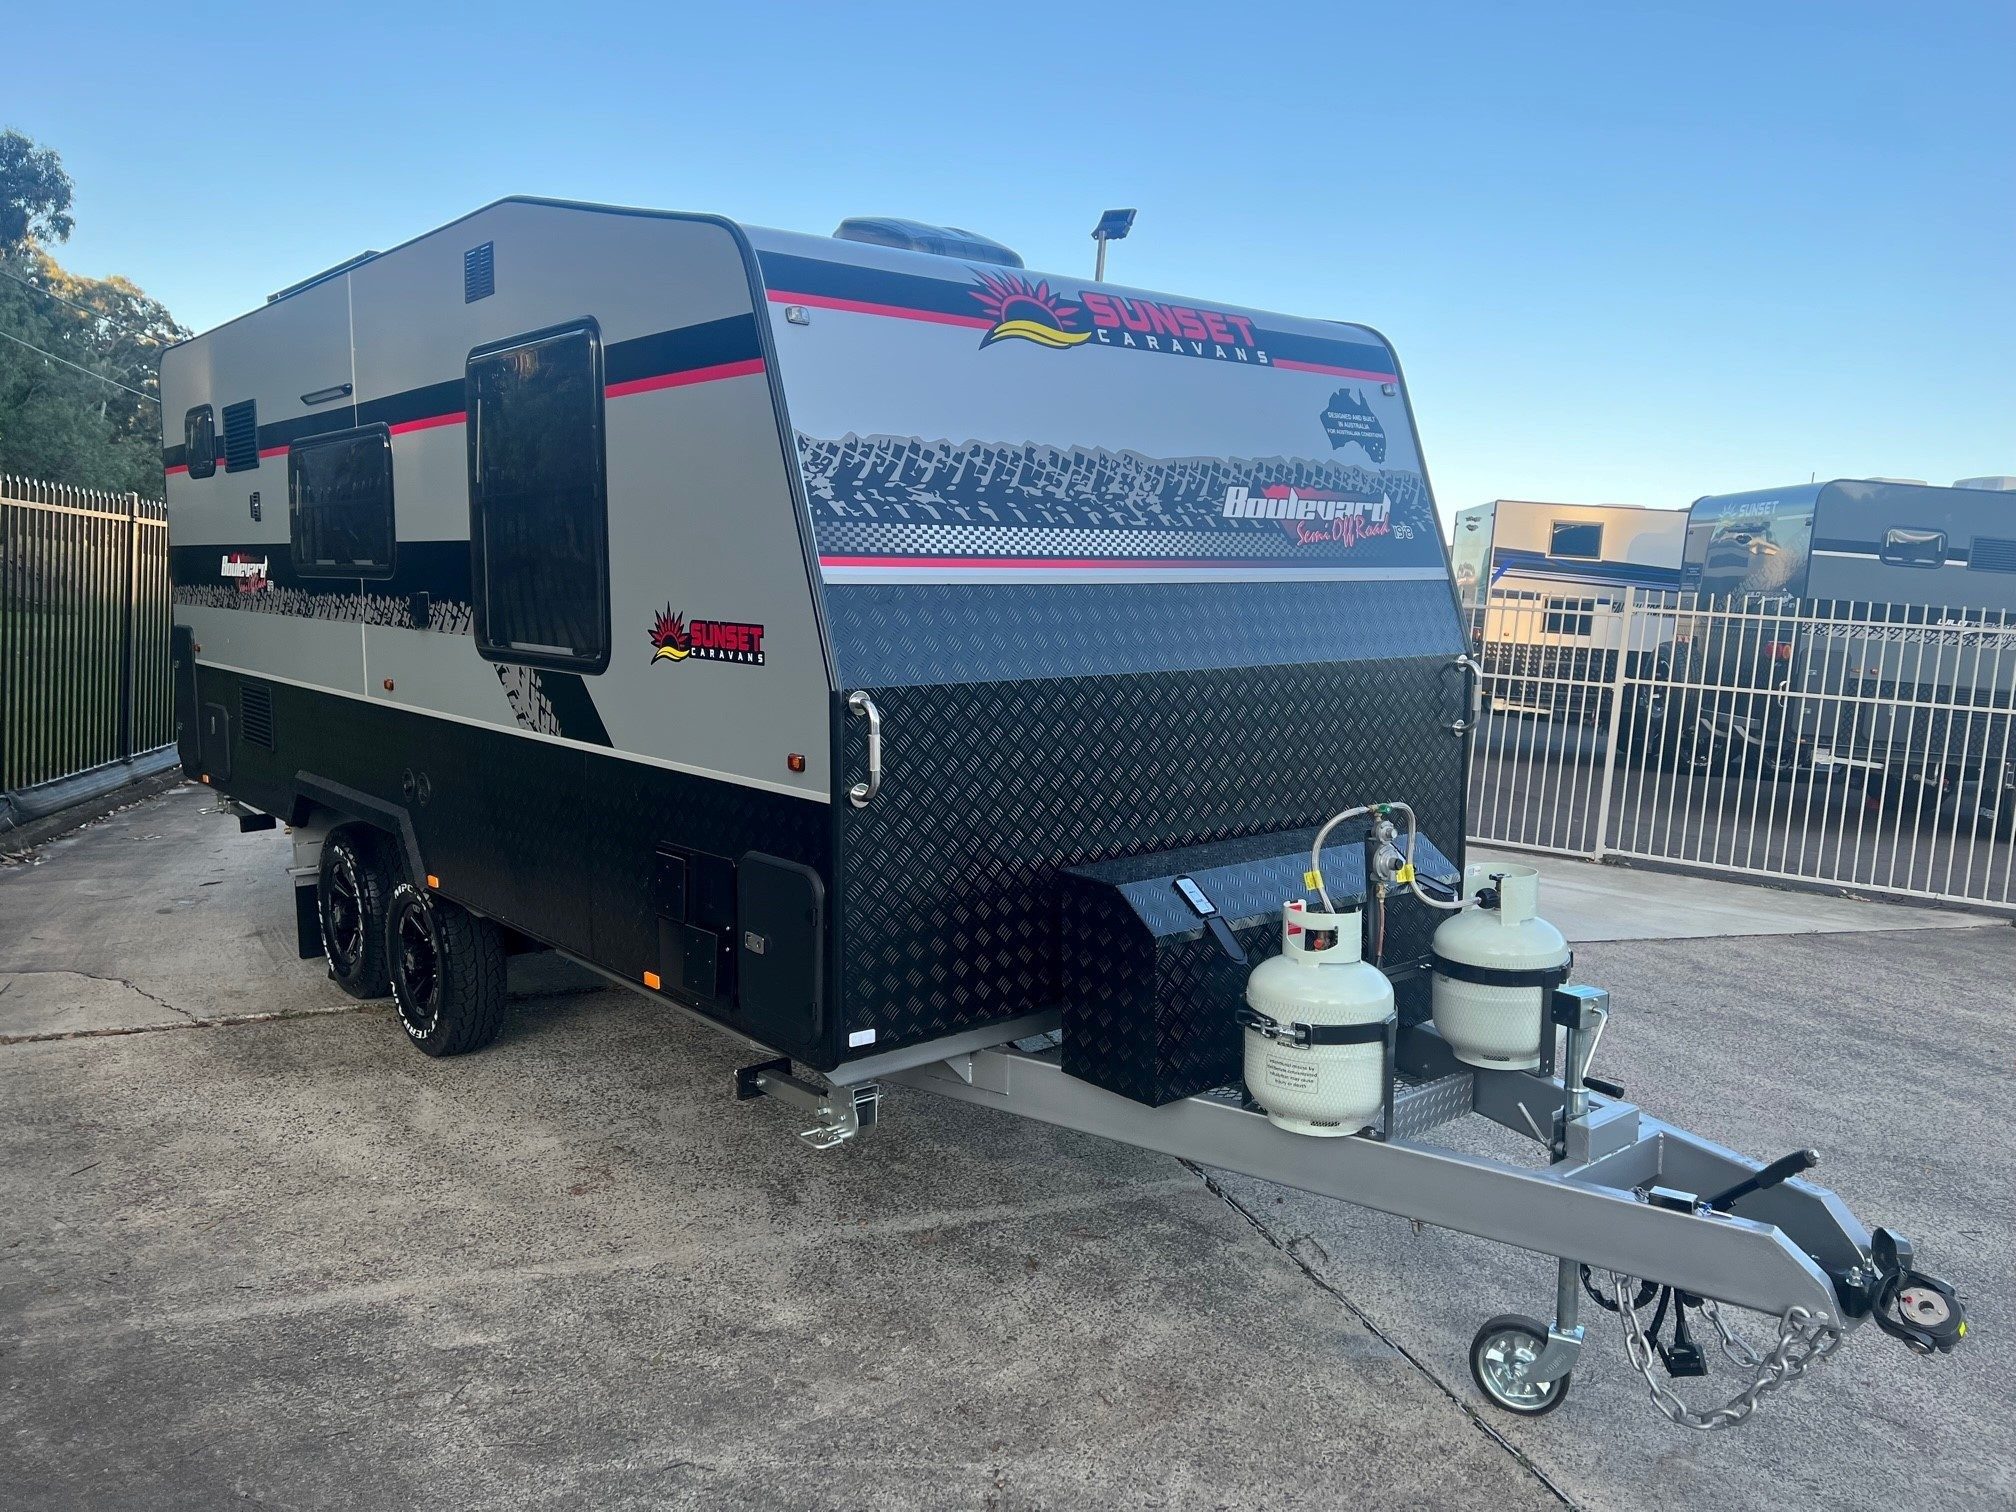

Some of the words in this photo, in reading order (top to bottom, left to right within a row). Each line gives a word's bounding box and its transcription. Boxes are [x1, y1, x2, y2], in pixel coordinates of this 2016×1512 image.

[1079, 291, 1255, 347] SUNSET
[1098, 329, 1269, 364] CARAVANS
[1327, 411, 1352, 420] DESIGNED
[1363, 415, 1375, 423] BUILT
[1344, 421, 1370, 430] AUSTRALIA
[1222, 486, 1392, 522] Boulevard
[1740, 500, 1780, 516] SUNSET
[1296, 520, 1331, 546] Semi
[1332, 516, 1355, 548] Off
[1355, 511, 1391, 539] Road
[689, 620, 764, 653] SUNSET
[691, 647, 764, 664] CARAVANS
